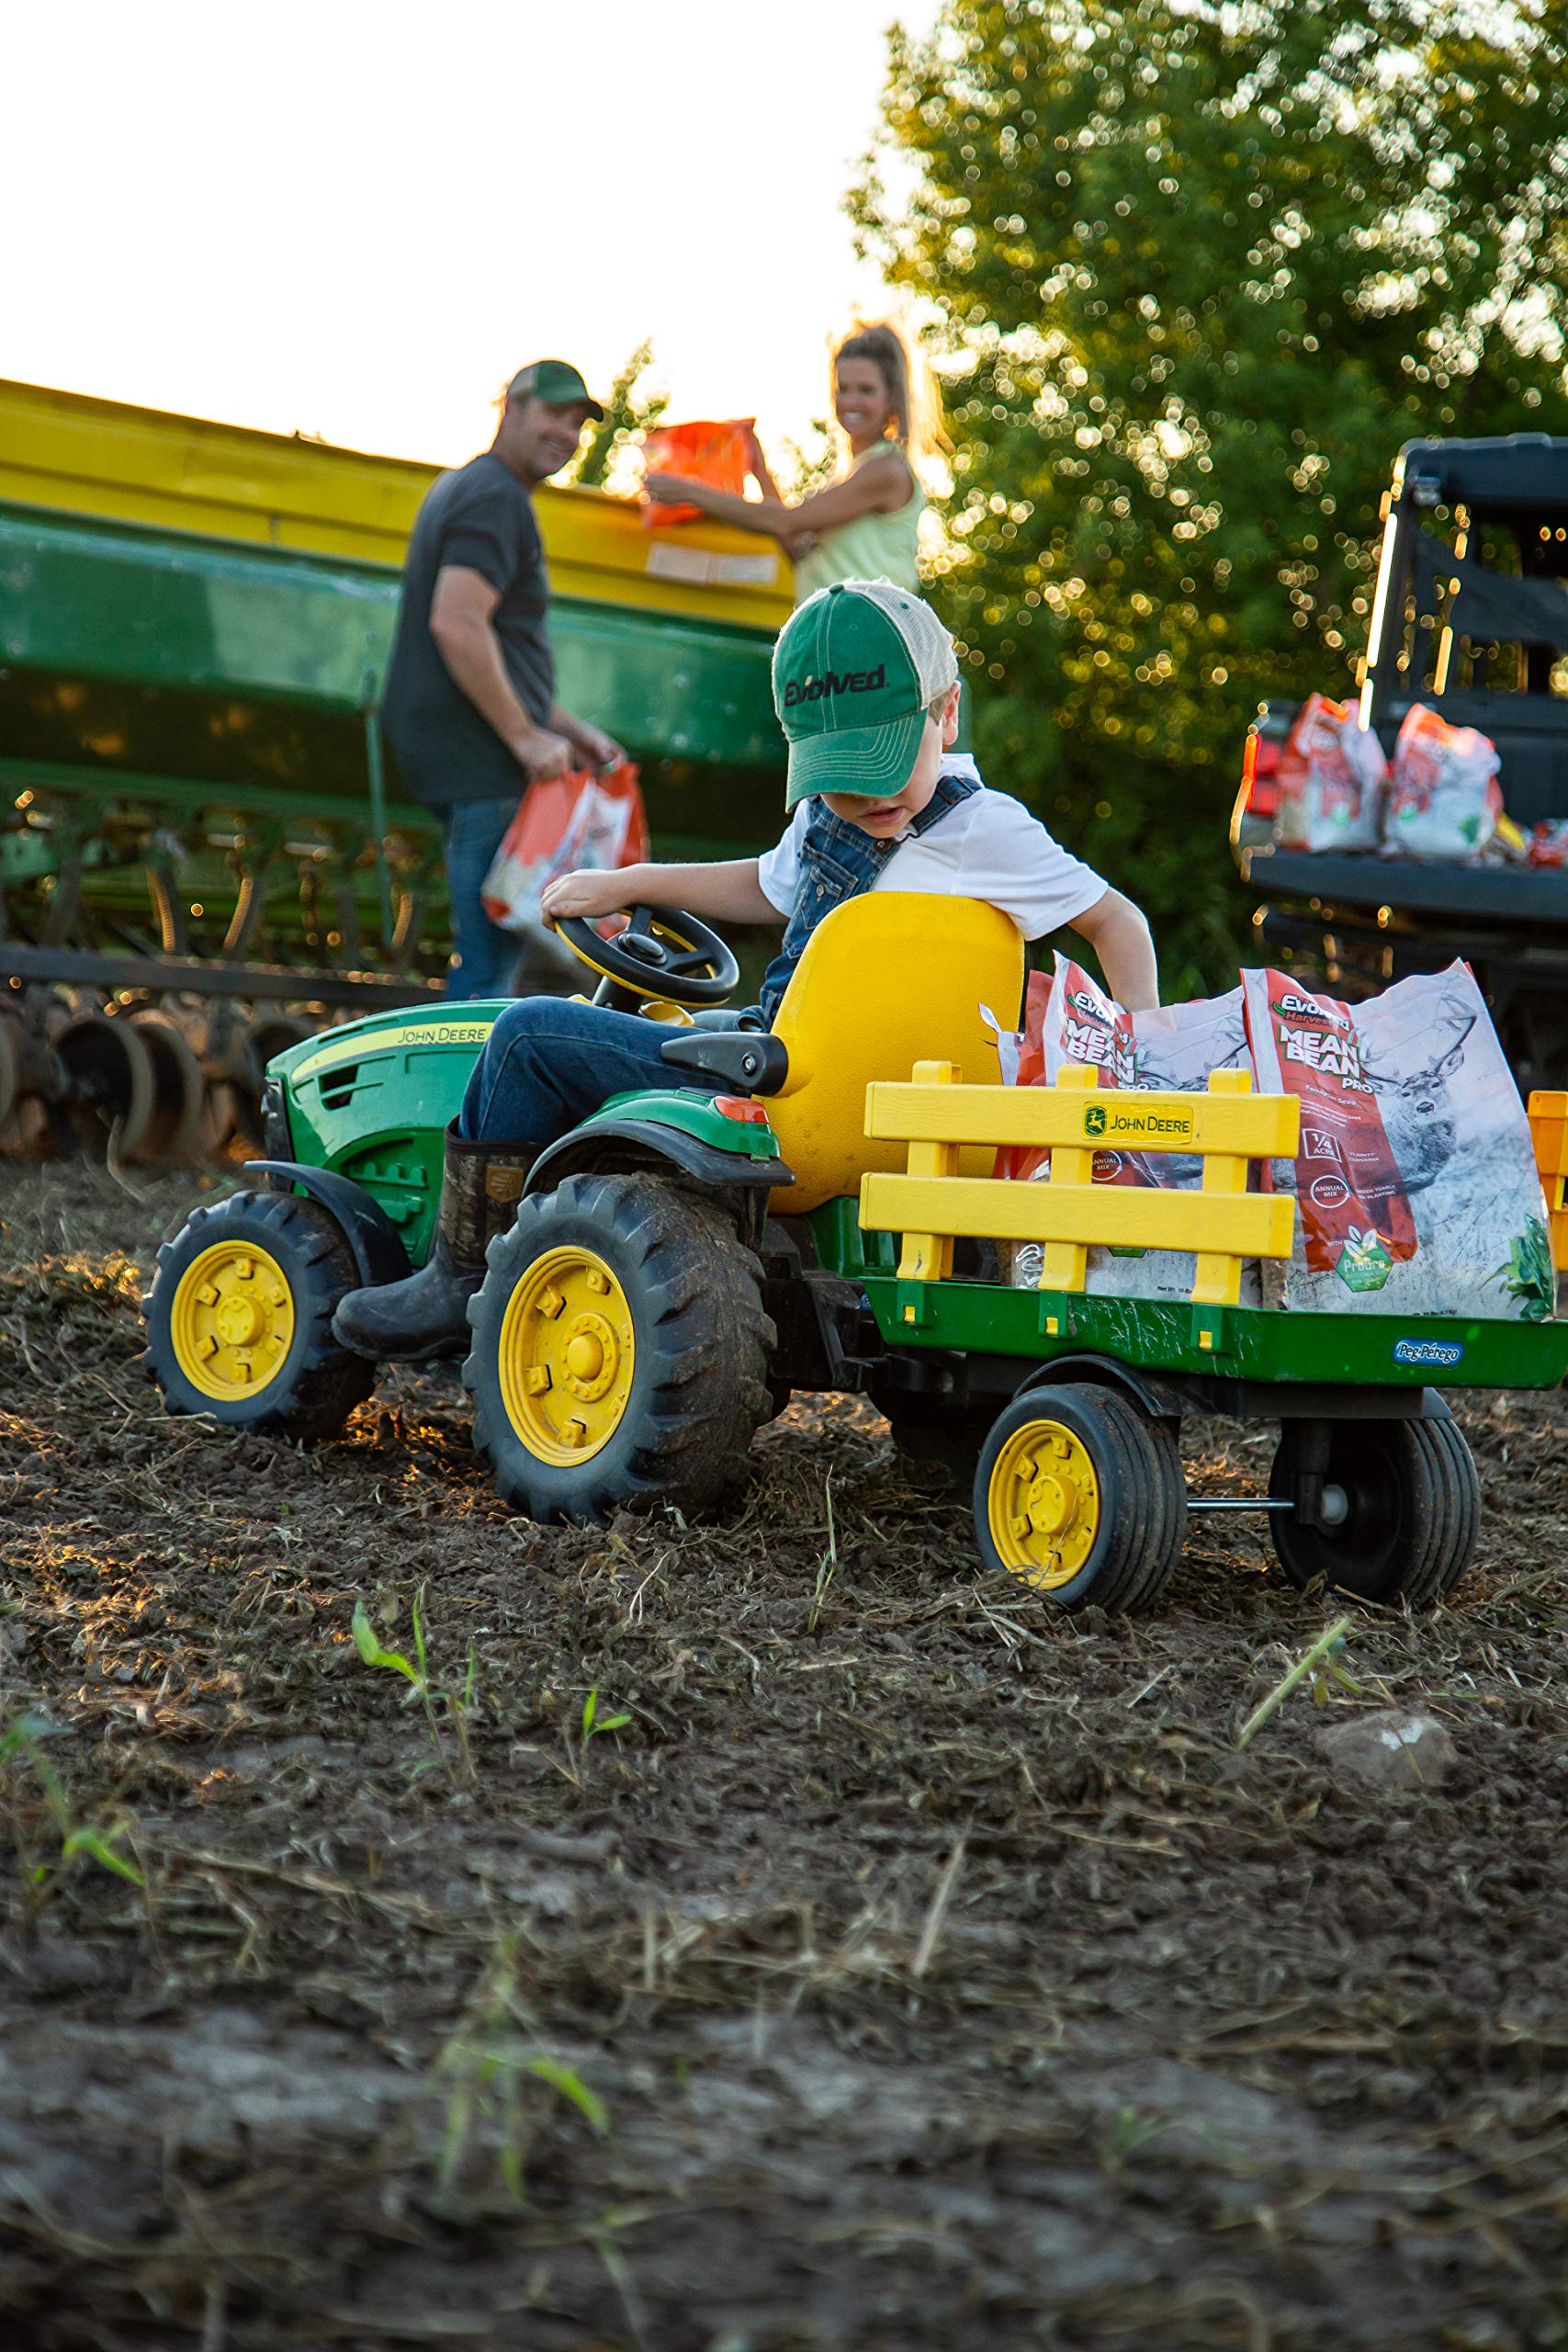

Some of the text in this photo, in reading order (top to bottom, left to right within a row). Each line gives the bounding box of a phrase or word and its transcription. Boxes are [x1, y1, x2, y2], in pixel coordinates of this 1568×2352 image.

[398, 1027, 486, 1044] JOHN DEERE
[1067, 1018, 1134, 1069] MEAN
[1280, 1023, 1358, 1061] MEAN
[1066, 1038, 1134, 1083] BEAN
[1287, 1042, 1359, 1079] BEAN
[1342, 1078, 1373, 1094] PRO
[1110, 1114, 1190, 1133] JOHN DEERE
[1312, 1133, 1333, 1149] 1/4
[1314, 1184, 1345, 1193] ANNUAL
[1374, 1184, 1396, 1193] YEARLY
